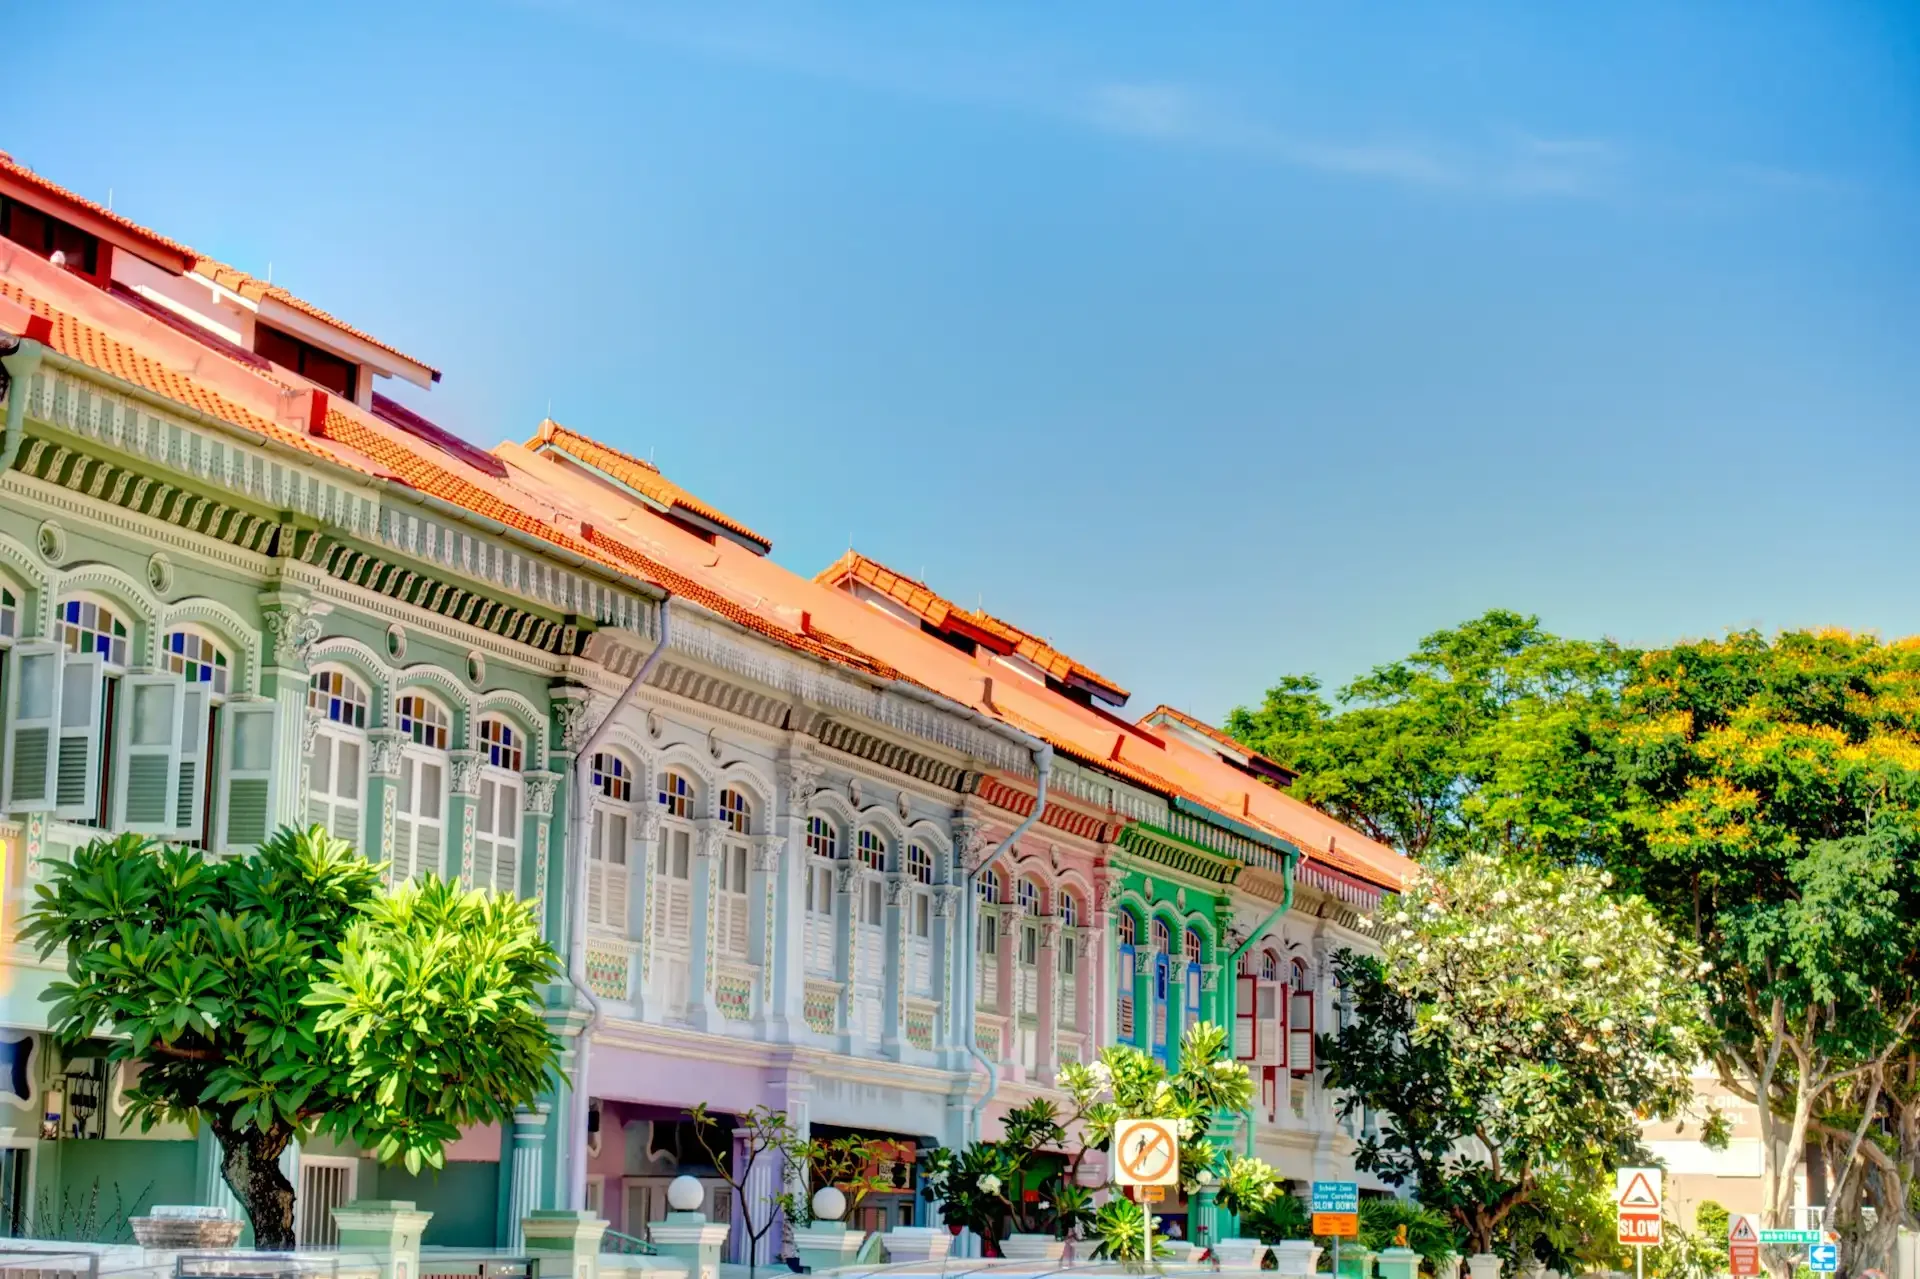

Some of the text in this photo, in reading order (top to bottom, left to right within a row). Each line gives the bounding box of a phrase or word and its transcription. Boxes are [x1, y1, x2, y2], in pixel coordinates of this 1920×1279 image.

[1314, 1201, 1357, 1210] SLOW DOWN
[1620, 1219, 1659, 1237] SLOW
[1806, 1231, 1818, 1241] Rd
[403, 1236, 408, 1248] 7
